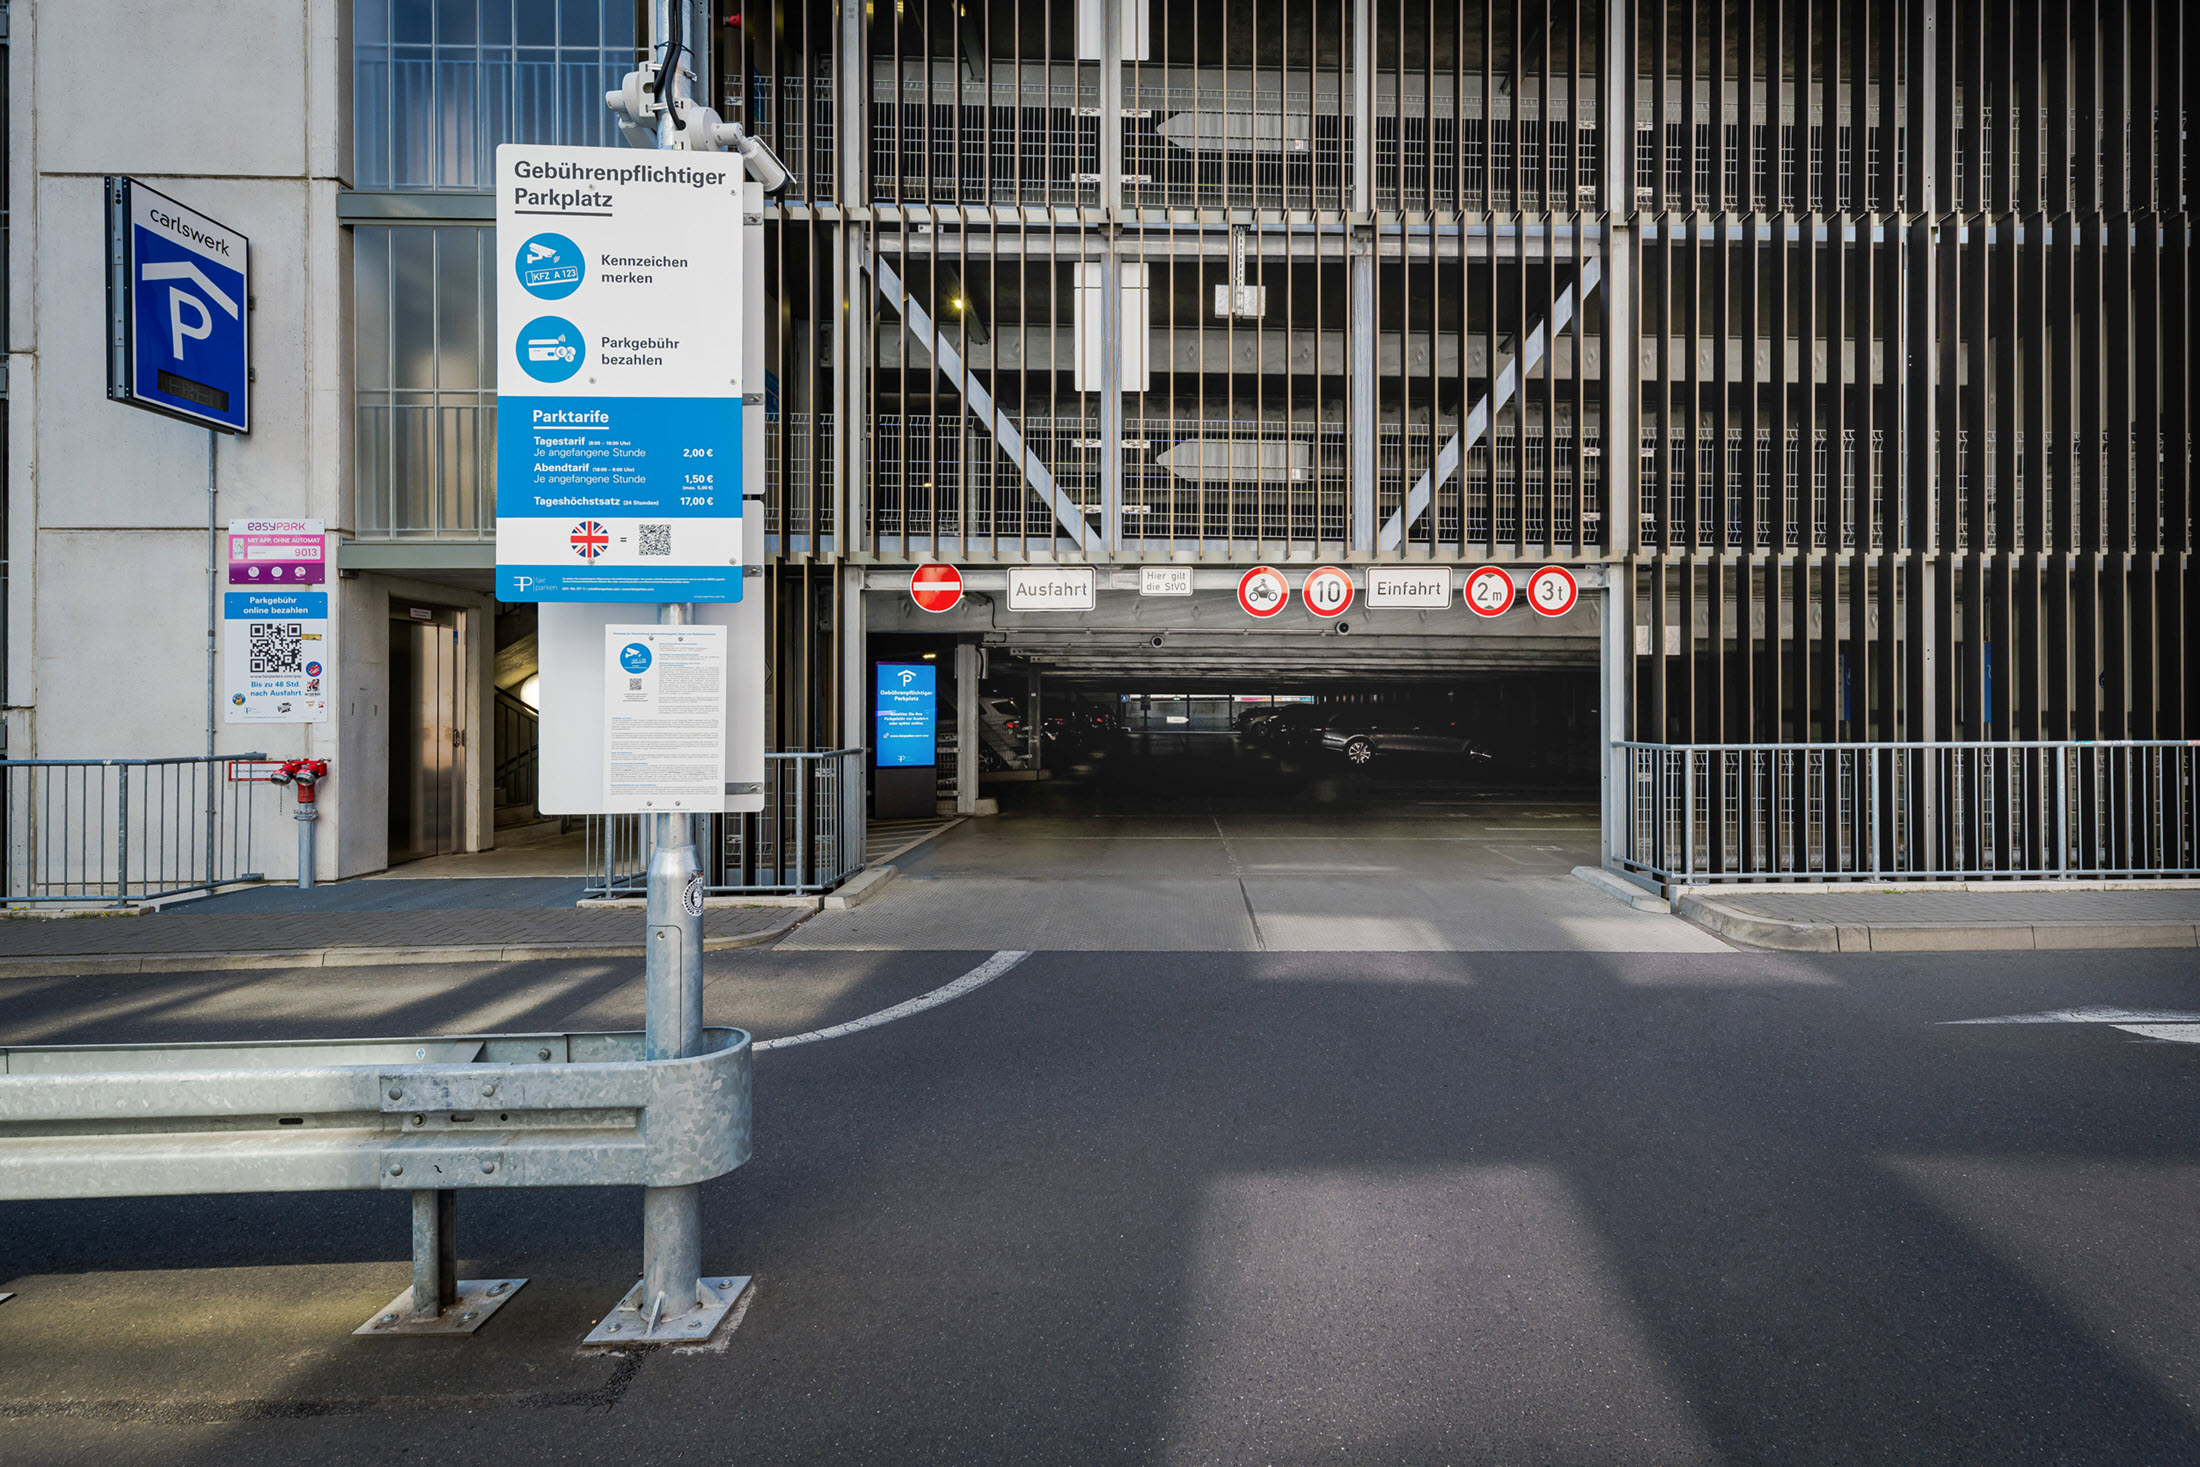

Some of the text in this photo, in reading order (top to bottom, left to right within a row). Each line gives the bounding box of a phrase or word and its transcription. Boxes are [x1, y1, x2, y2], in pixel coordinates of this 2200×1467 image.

[514, 160, 726, 188] Gebührenpflichtiger
[514, 188, 613, 210] Parkplatz
[150, 209, 230, 257] carlswerk
[601, 254, 688, 268] Kennzeichen
[533, 269, 577, 281] KFZ A 123
[601, 271, 653, 284] merken
[169, 286, 213, 361] P
[601, 336, 680, 351] Parkgebühr
[601, 353, 663, 366] bezahlen
[532, 409, 610, 424] Parktarife
[533, 436, 586, 447] Tagestarif
[533, 448, 714, 459] Je angefangene Stunde 2,00 €
[533, 463, 590, 473] Abendtarif
[533, 474, 714, 486] Je angefangene Stunde 1,50 €
[533, 496, 620, 508] Tageshöchstsatz
[680, 496, 706, 506] 17,00
[706, 496, 714, 506] €
[294, 548, 318, 557] 9013
[1146, 571, 1186, 582] Hier gilt
[1015, 582, 1088, 597] Ausfahrt
[1146, 582, 1187, 592] die StVO
[1316, 580, 1341, 603] 10
[1377, 581, 1441, 596] Einfahrt
[1477, 582, 1503, 602] 2 m
[1541, 580, 1564, 602] 3 t
[249, 596, 298, 606] Parkgebühr
